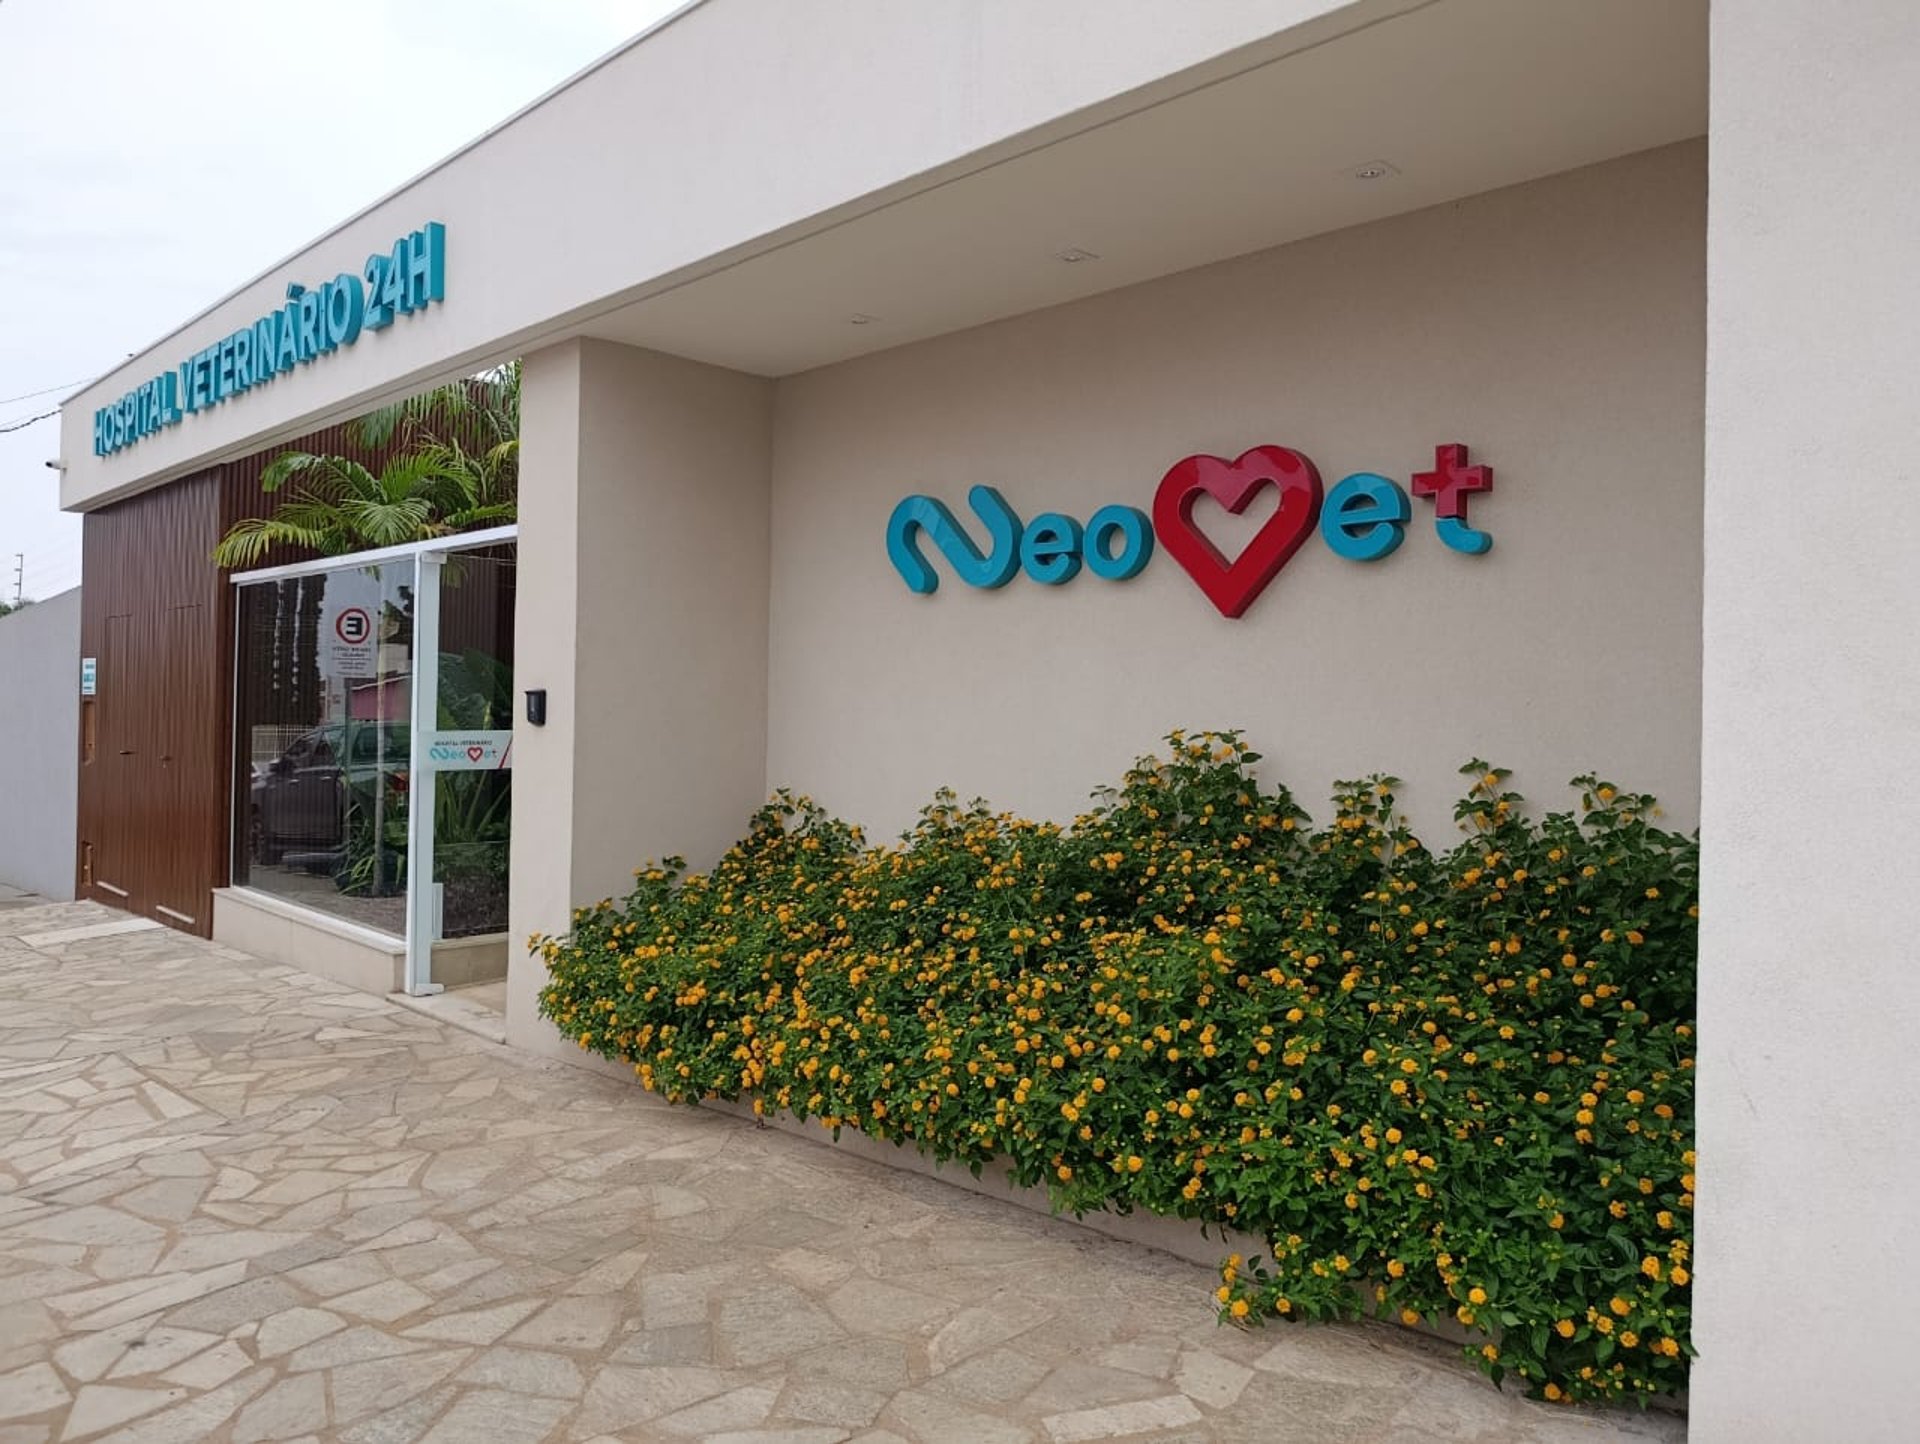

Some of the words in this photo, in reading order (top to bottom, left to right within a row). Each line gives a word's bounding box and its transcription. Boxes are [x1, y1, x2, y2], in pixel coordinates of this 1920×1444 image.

[94, 371, 182, 457] HOSPITAL
[177, 273, 364, 413] VETERINÁRIO
[364, 220, 446, 331] 24H
